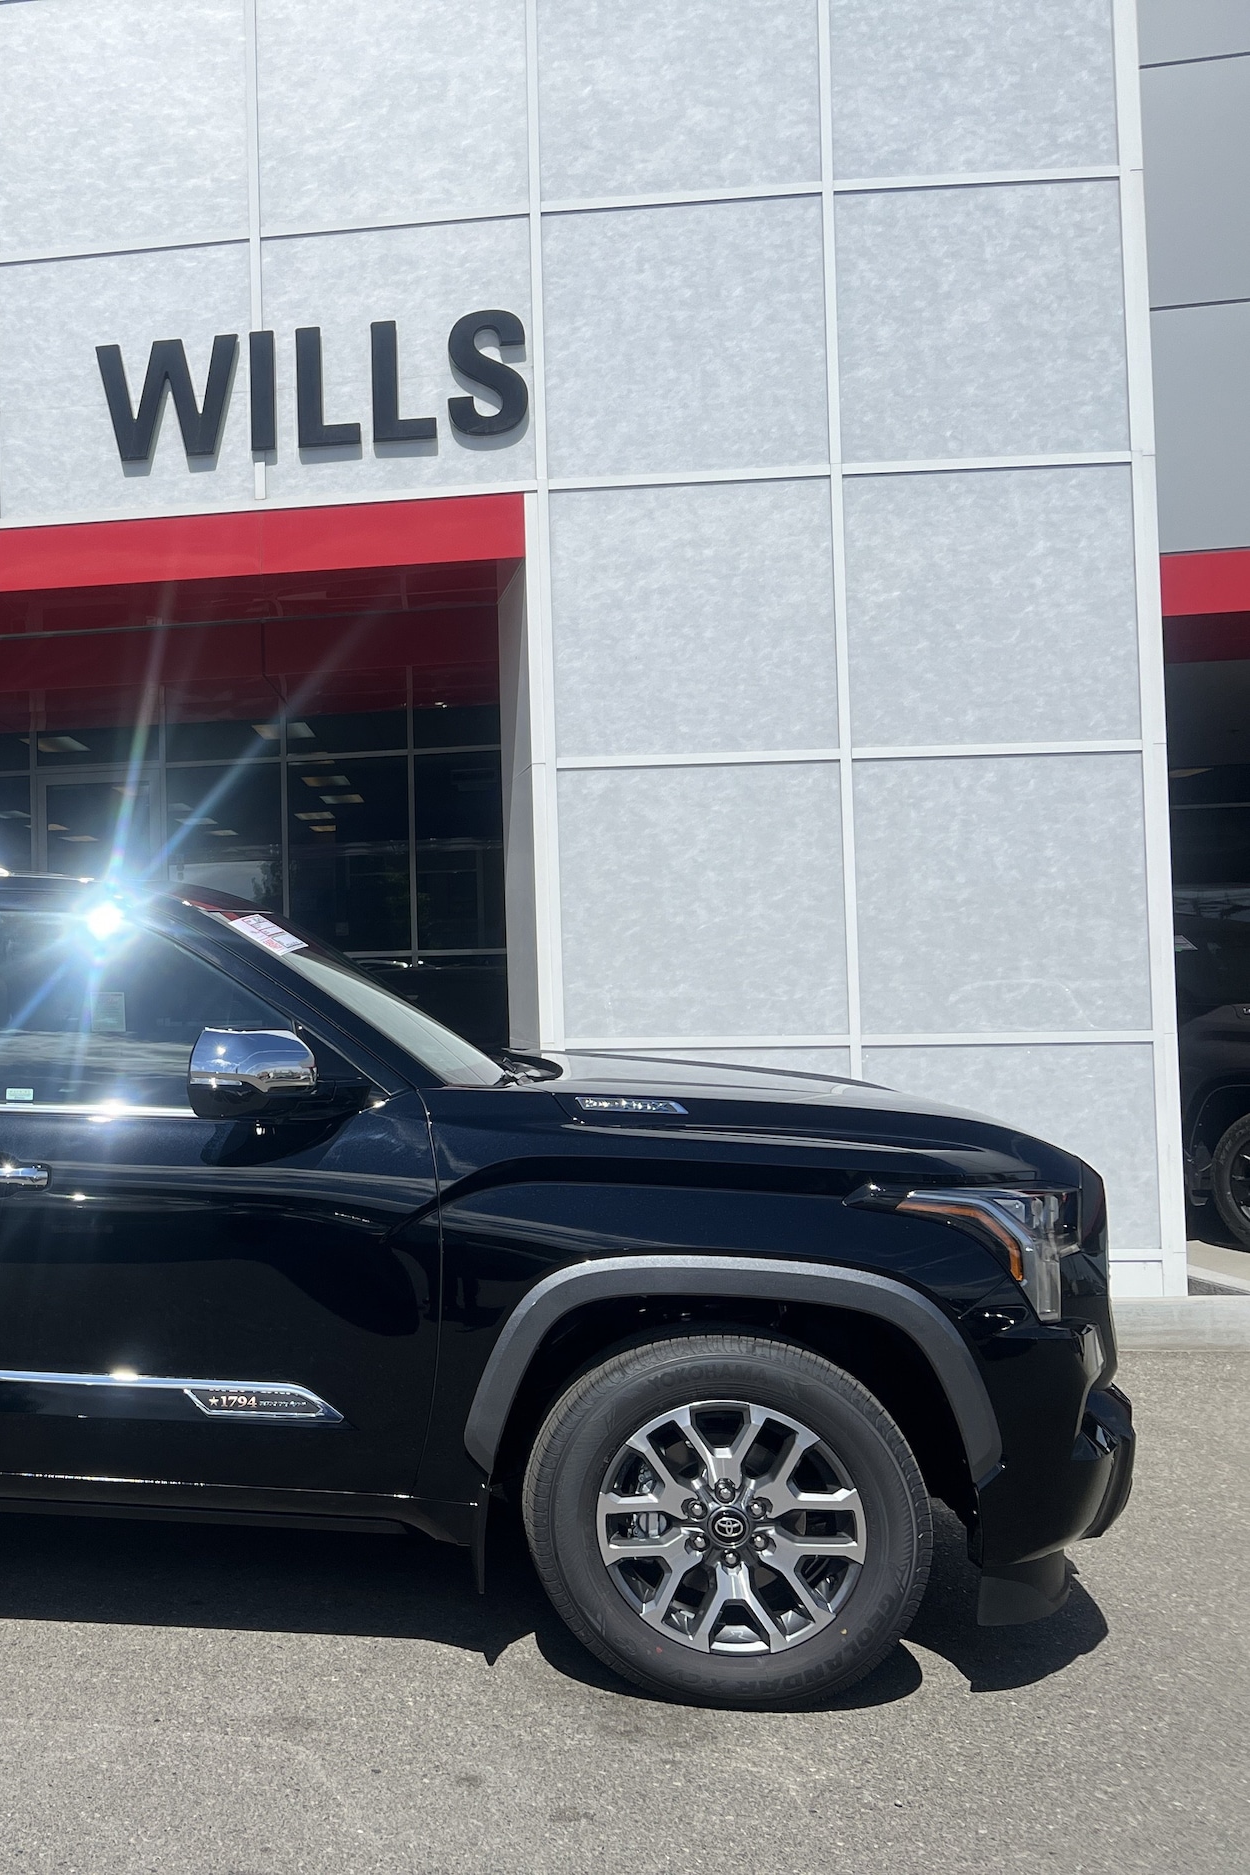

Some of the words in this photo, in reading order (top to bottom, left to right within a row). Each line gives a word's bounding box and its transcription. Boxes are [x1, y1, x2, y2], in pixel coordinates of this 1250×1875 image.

[95, 309, 529, 461] WILLS
[648, 1363, 769, 1392] YOKOHAMA
[220, 1395, 258, 1408] 1794
